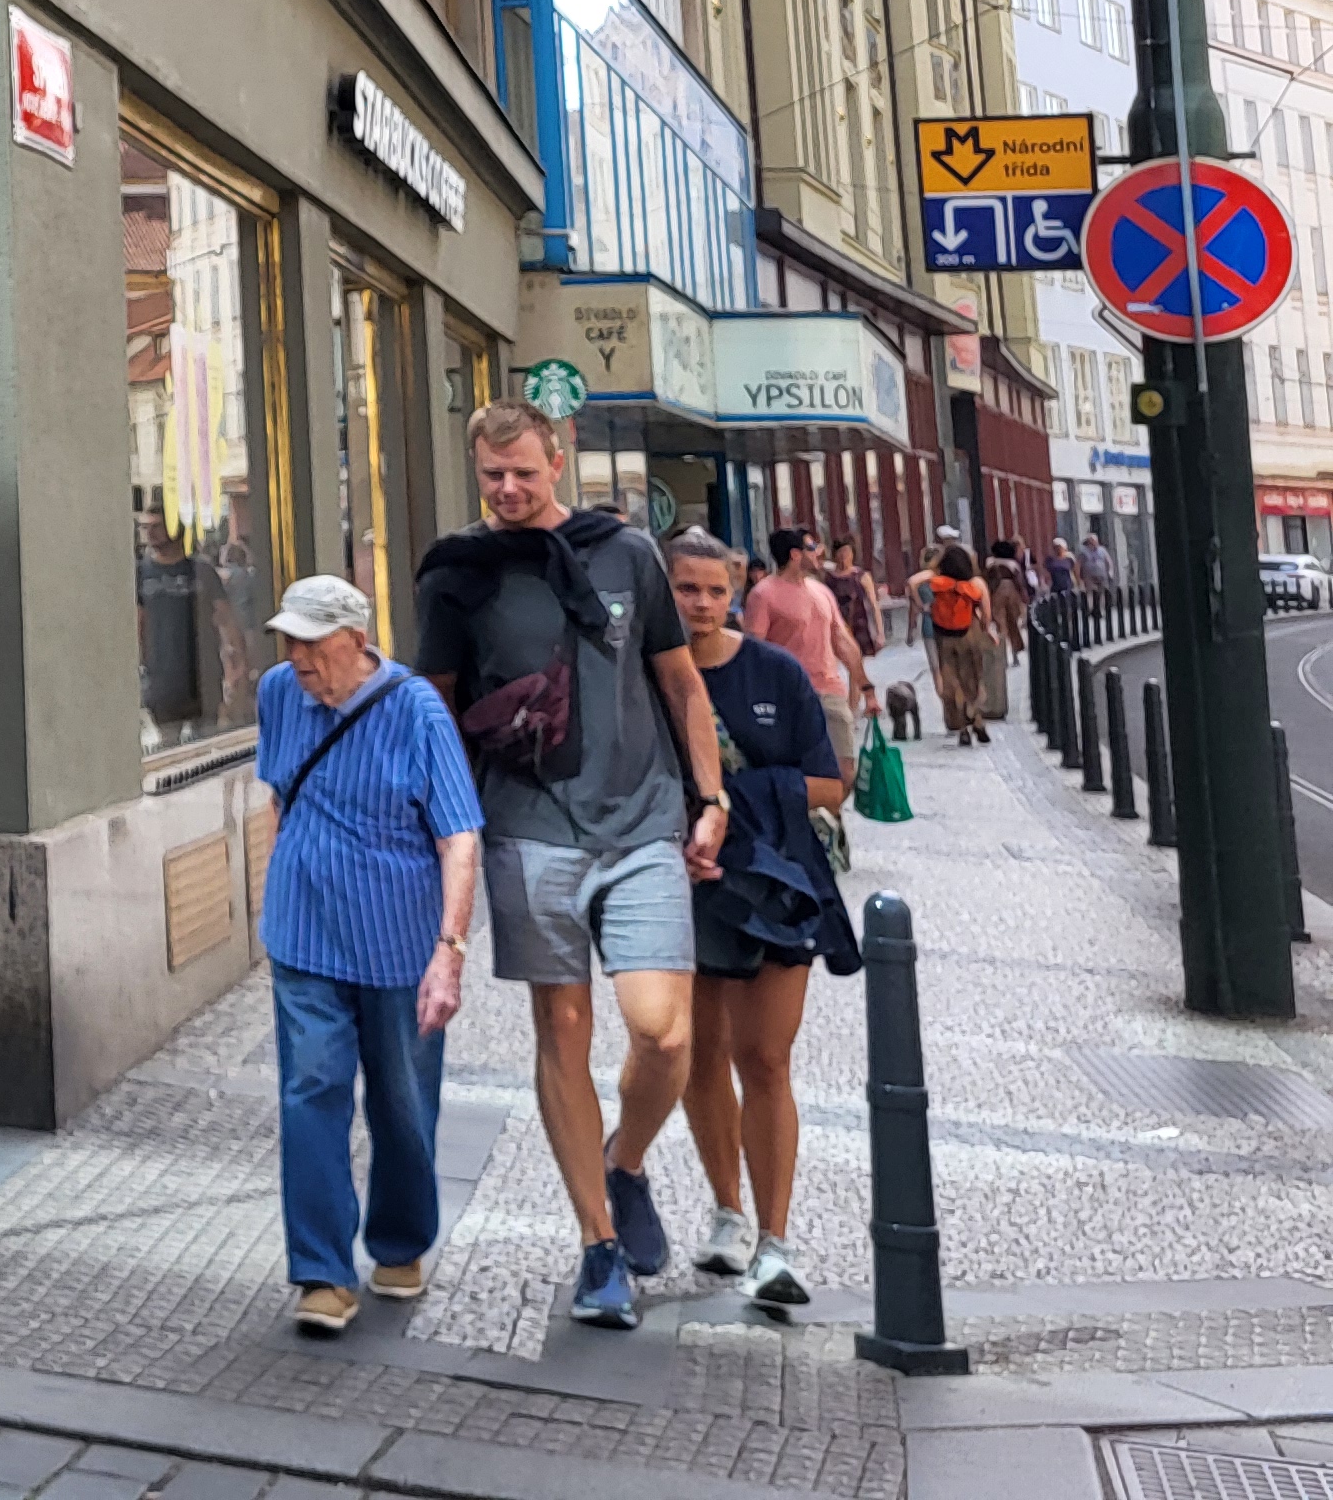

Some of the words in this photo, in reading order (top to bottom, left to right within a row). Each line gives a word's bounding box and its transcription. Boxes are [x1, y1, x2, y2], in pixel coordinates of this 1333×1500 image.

[1002, 136, 1085, 156] Národní
[1003, 161, 1051, 179] třída
[743, 382, 865, 411] YPSILON
